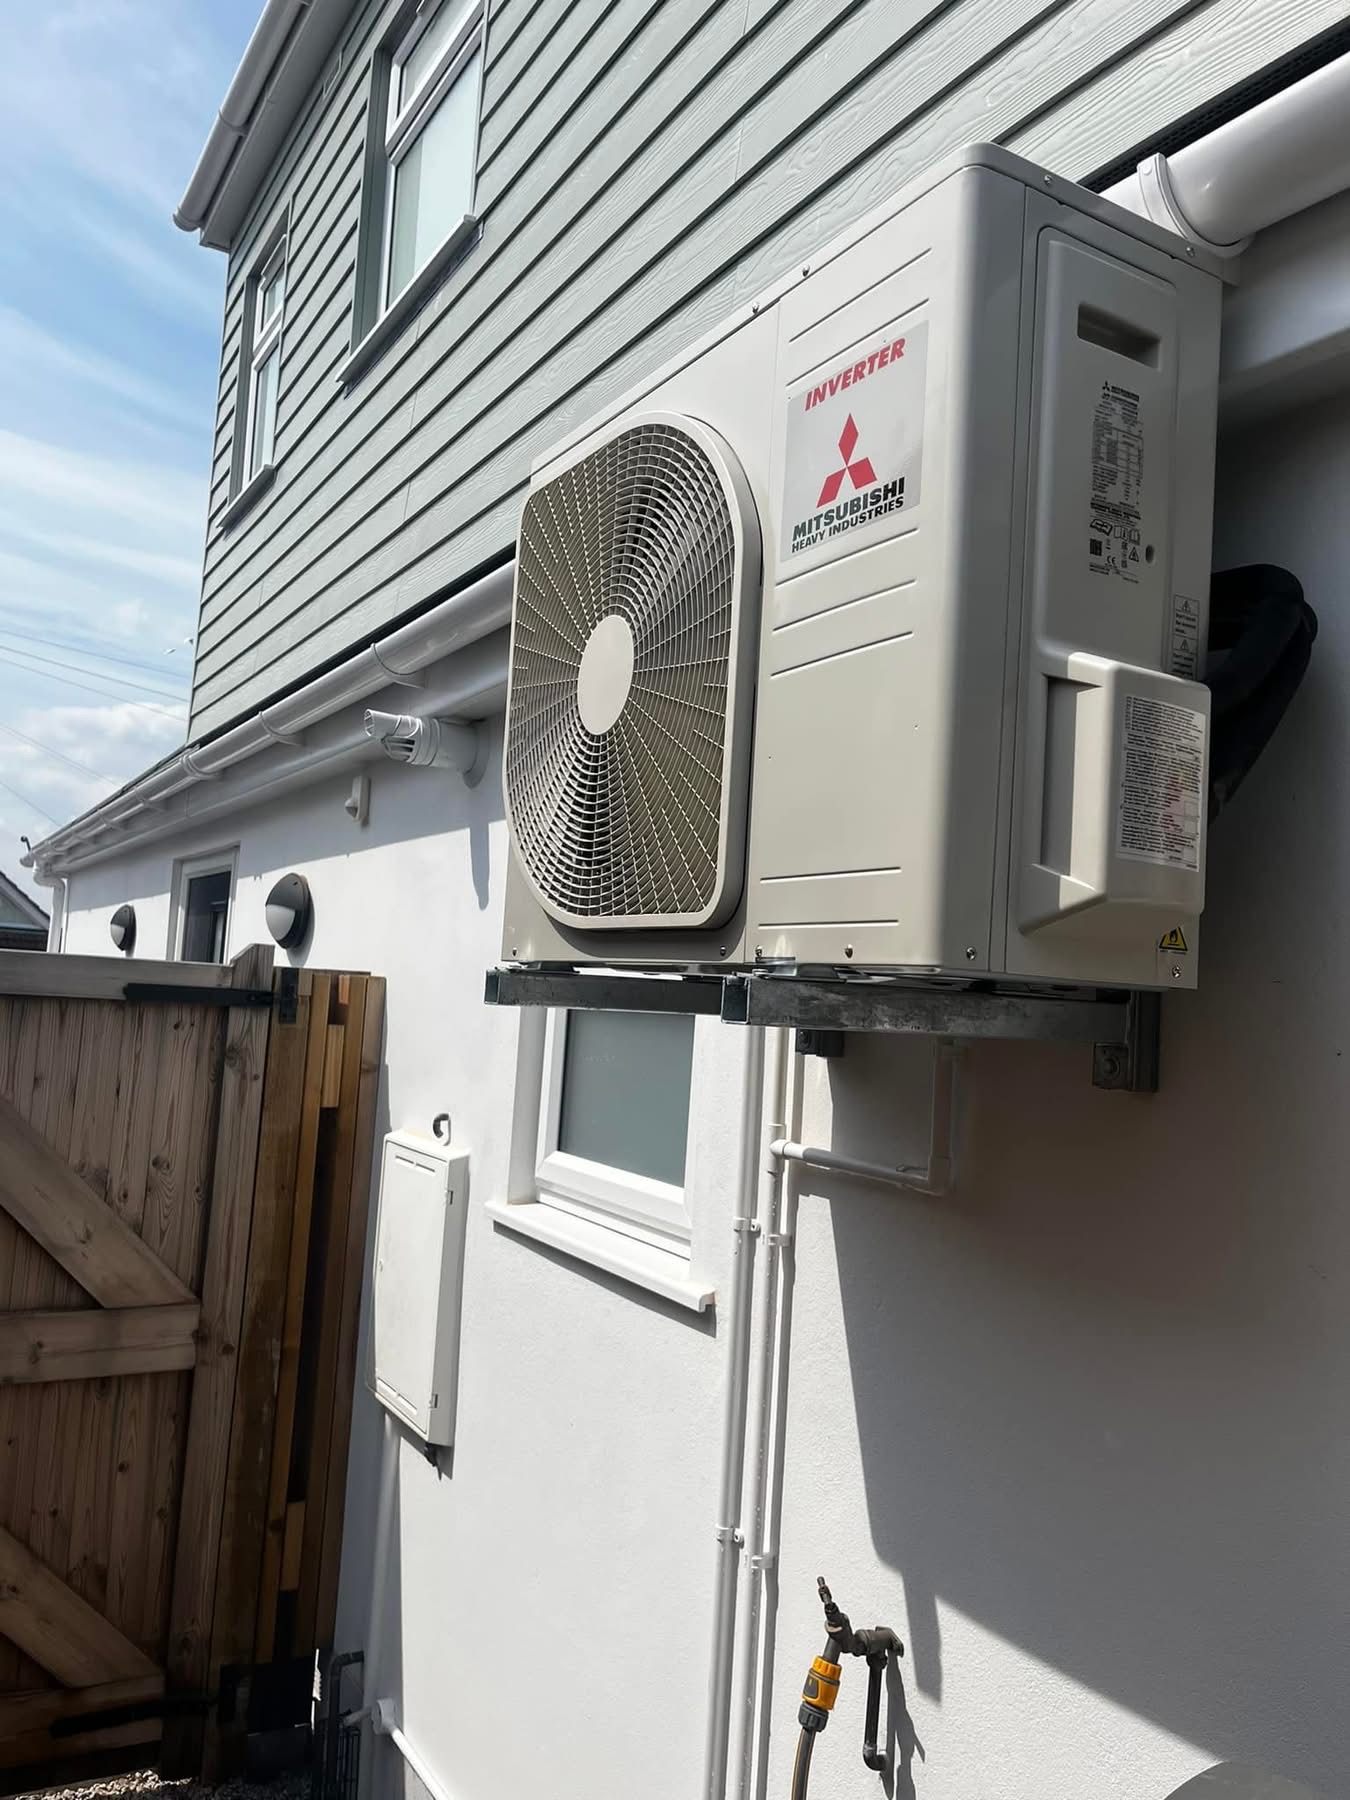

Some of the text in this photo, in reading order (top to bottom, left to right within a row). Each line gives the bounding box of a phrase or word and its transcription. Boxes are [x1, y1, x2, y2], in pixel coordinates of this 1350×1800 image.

[804, 338, 906, 412] INVERTER
[791, 496, 904, 553] HEAVY INDUSTRIES
[792, 476, 905, 542] MITSUBISHI
